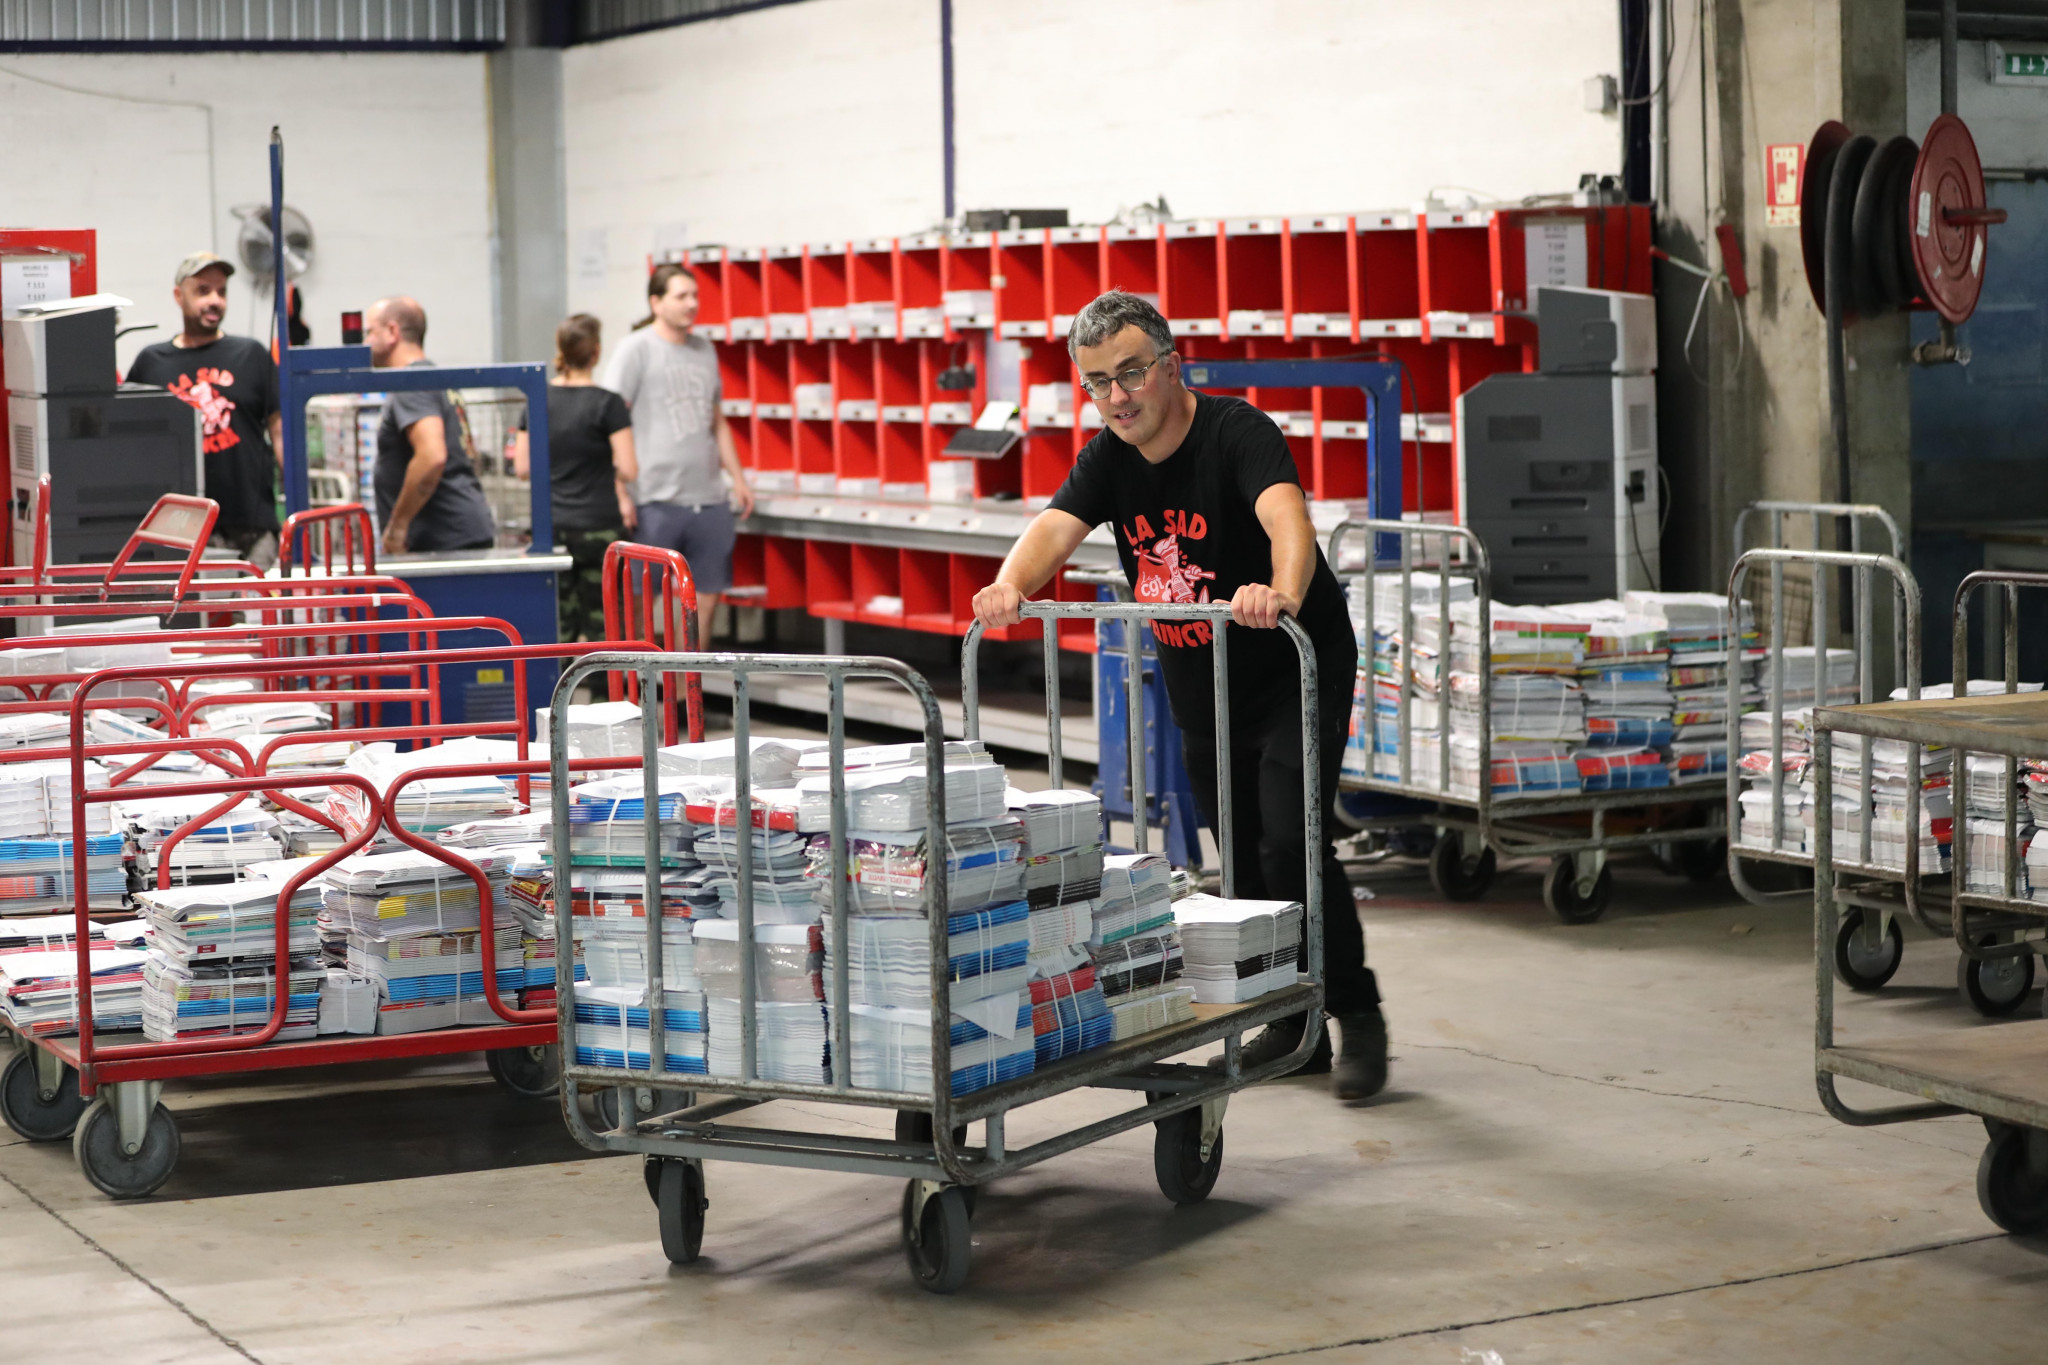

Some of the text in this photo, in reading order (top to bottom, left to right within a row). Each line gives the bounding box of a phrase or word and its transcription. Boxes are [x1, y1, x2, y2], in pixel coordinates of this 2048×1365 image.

[1123, 509, 1208, 547] LA SAD
[1141, 575, 1165, 597] cgt
